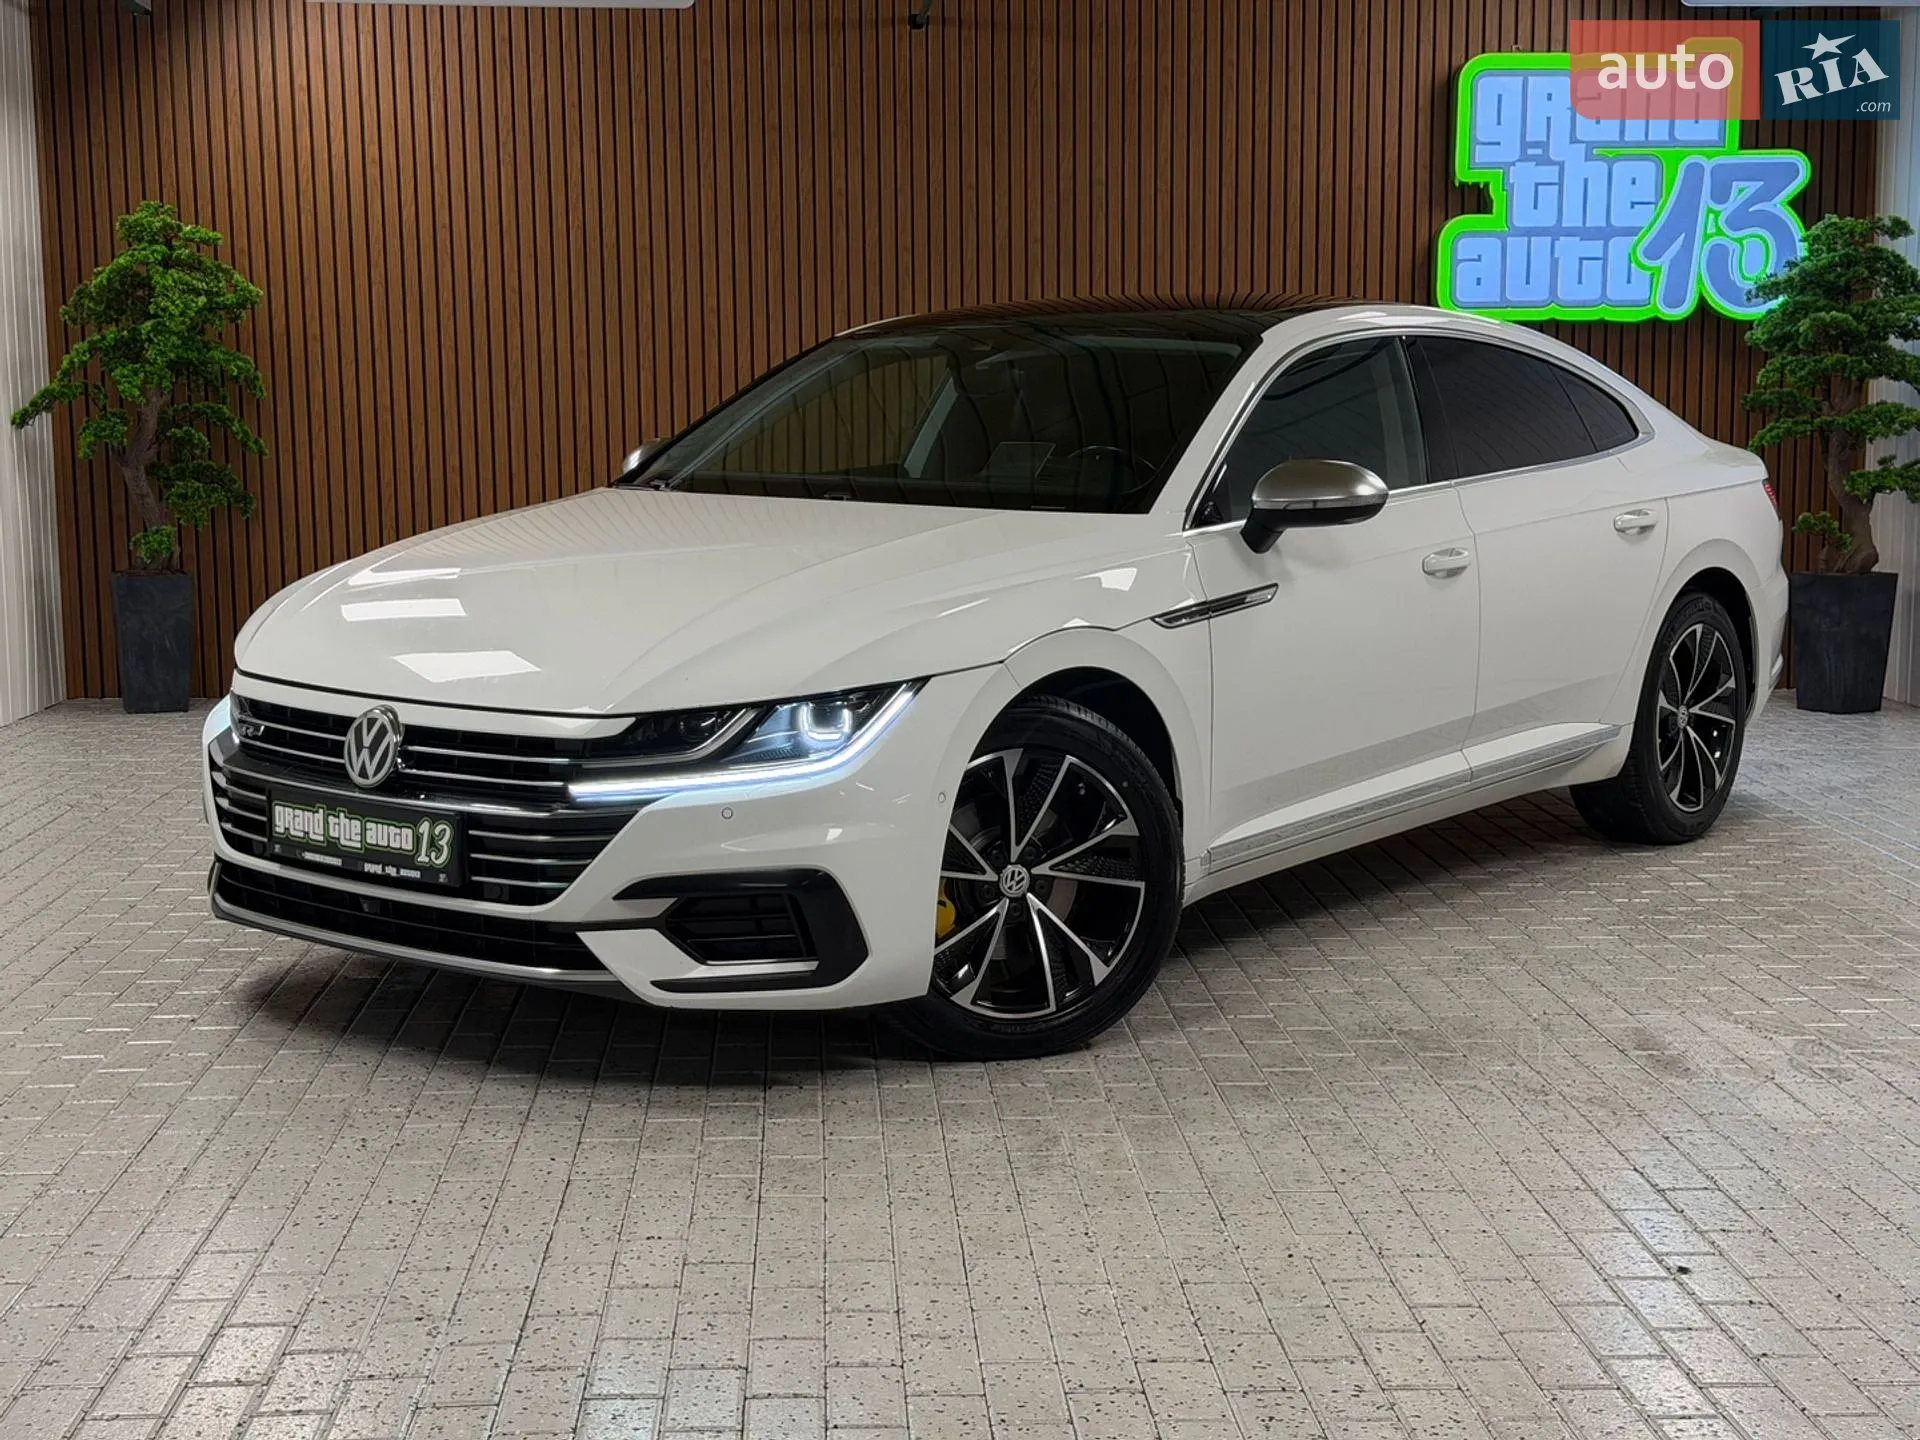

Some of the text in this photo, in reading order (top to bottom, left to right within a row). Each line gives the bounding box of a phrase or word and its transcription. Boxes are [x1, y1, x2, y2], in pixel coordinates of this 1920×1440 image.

[1509, 145, 1658, 228] the
[1635, 155, 1806, 314] 13
[328, 811, 362, 849] the
[365, 819, 413, 852] auto
[417, 819, 452, 865] 13
